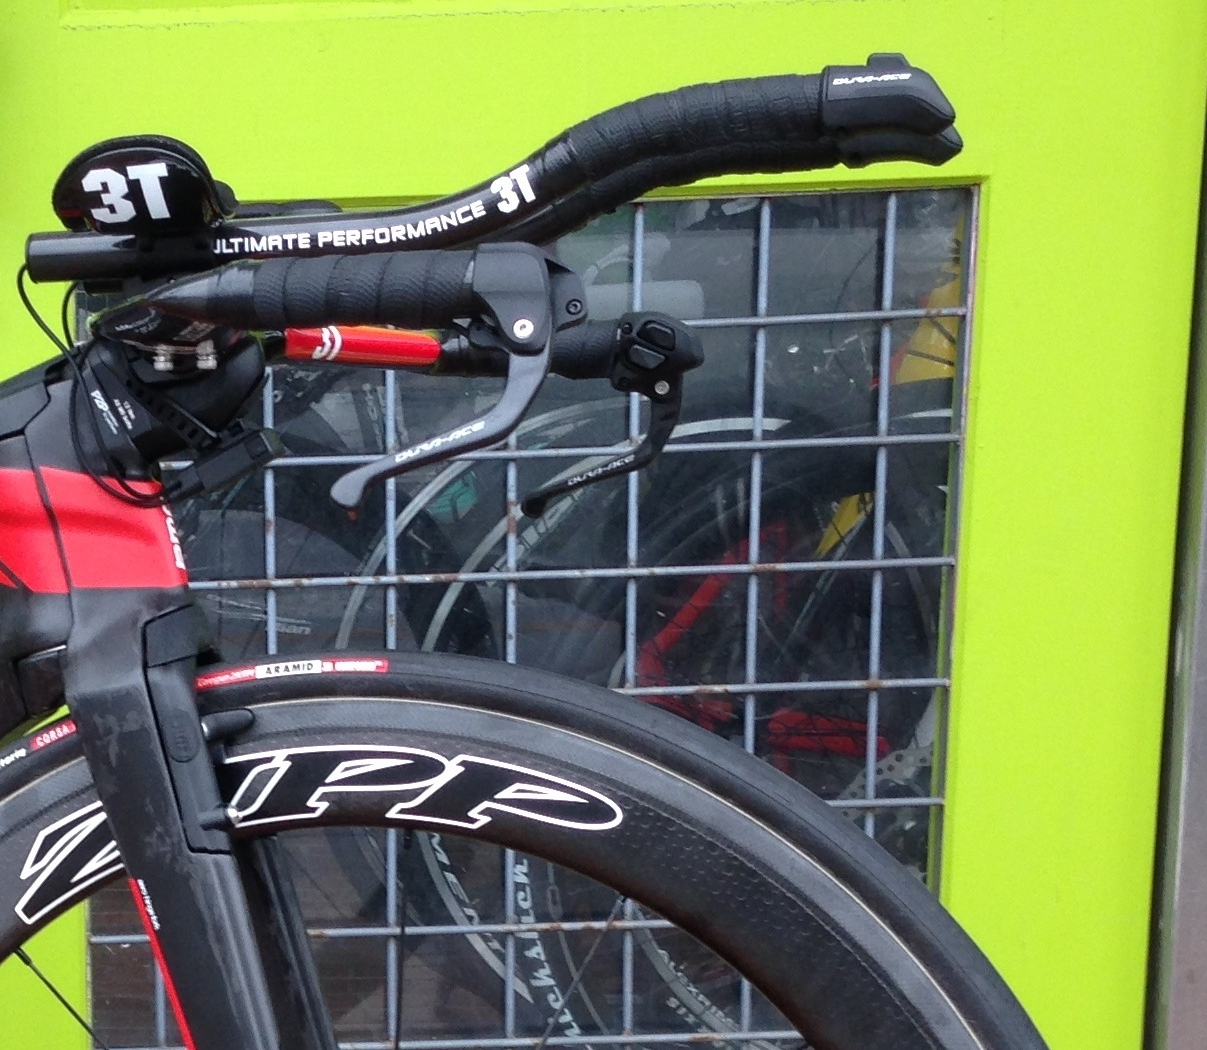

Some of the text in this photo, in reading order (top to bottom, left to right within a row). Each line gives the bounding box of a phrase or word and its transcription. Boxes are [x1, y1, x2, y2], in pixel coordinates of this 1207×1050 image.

[81, 162, 171, 224] 3T
[317, 200, 487, 248] PERFORMANCE
[490, 163, 536, 214] 3T
[265, 661, 315, 675] ARAMID
[36, 724, 71, 748] CORSA
